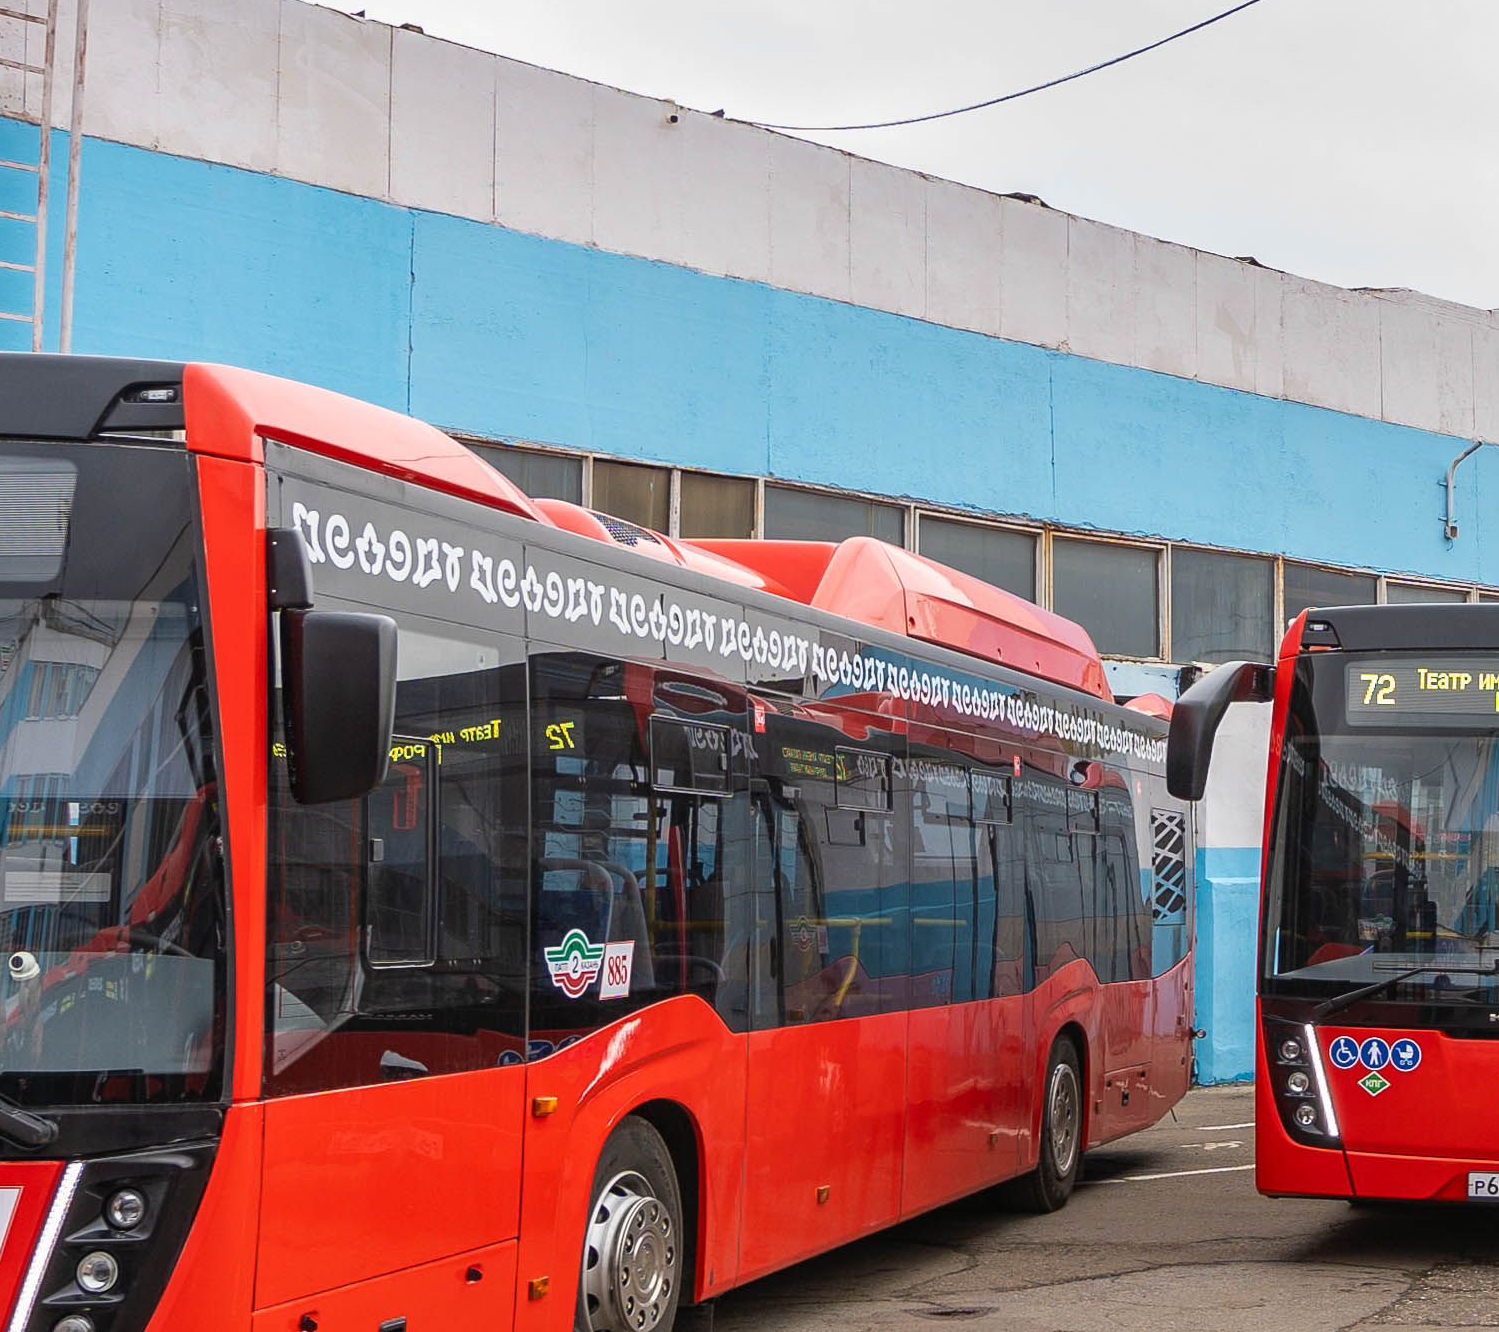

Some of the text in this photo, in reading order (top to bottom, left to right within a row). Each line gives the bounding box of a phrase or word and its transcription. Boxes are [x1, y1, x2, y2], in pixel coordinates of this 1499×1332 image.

[1360, 673, 1396, 706] 72
[1417, 668, 1472, 691] Театр
[571, 955, 579, 974] 2
[607, 954, 628, 987] 885
